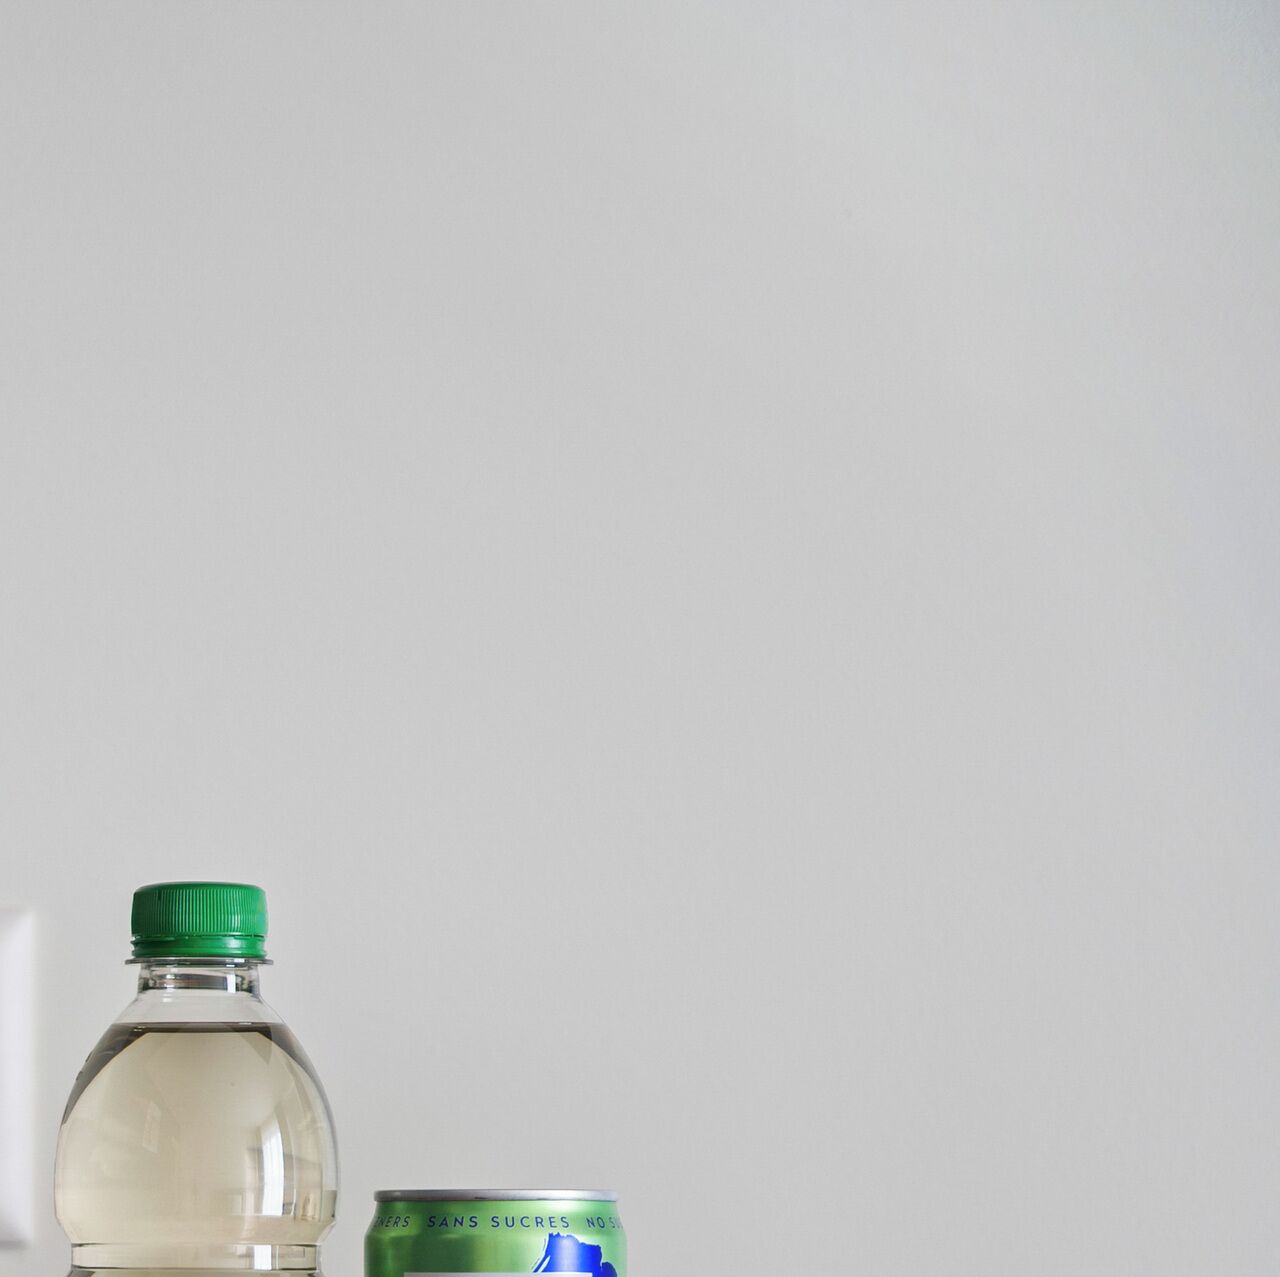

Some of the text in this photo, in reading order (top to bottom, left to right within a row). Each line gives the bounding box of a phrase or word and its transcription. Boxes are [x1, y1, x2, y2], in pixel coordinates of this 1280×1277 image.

[427, 1215, 478, 1229] SANS
[491, 1215, 571, 1229] SUCRES
[586, 1216, 606, 1229] NO
